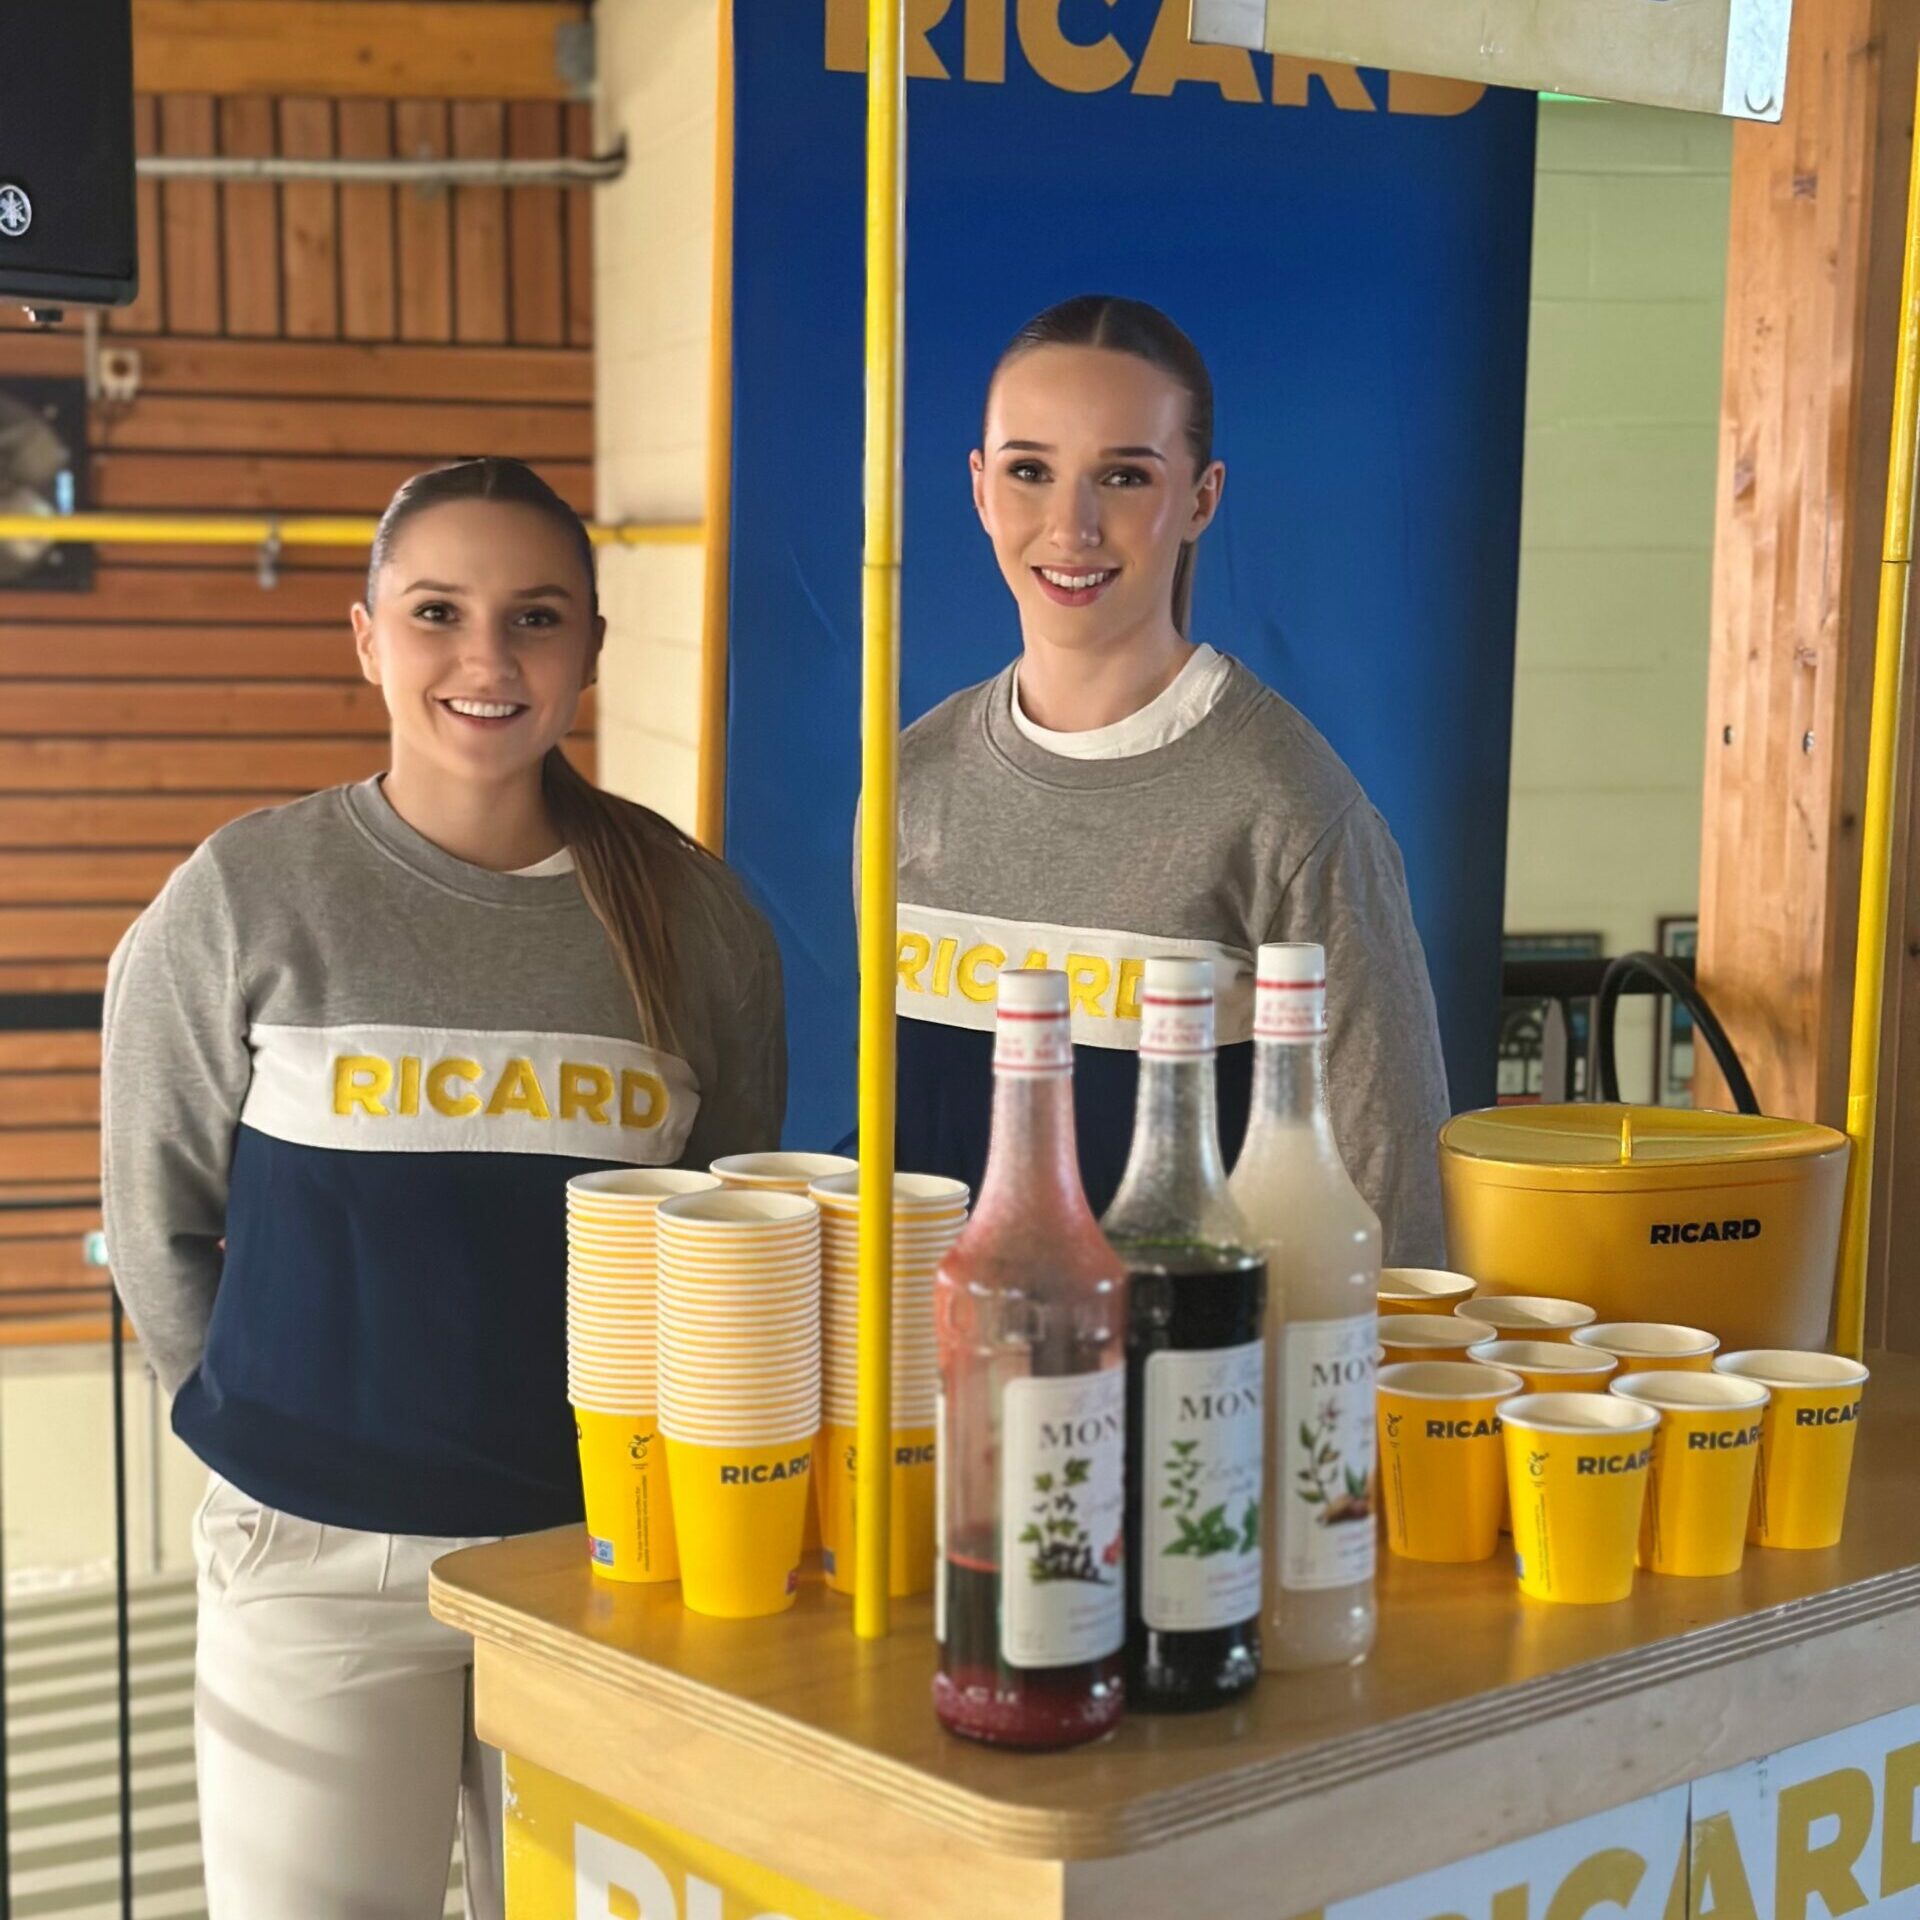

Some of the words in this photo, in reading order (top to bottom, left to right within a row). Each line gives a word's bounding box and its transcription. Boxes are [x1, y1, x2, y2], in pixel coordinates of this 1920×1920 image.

[824, 0, 1488, 117] RICA
[333, 1055, 669, 1130] RICARD
[1649, 1218, 1762, 1245] RICARD
